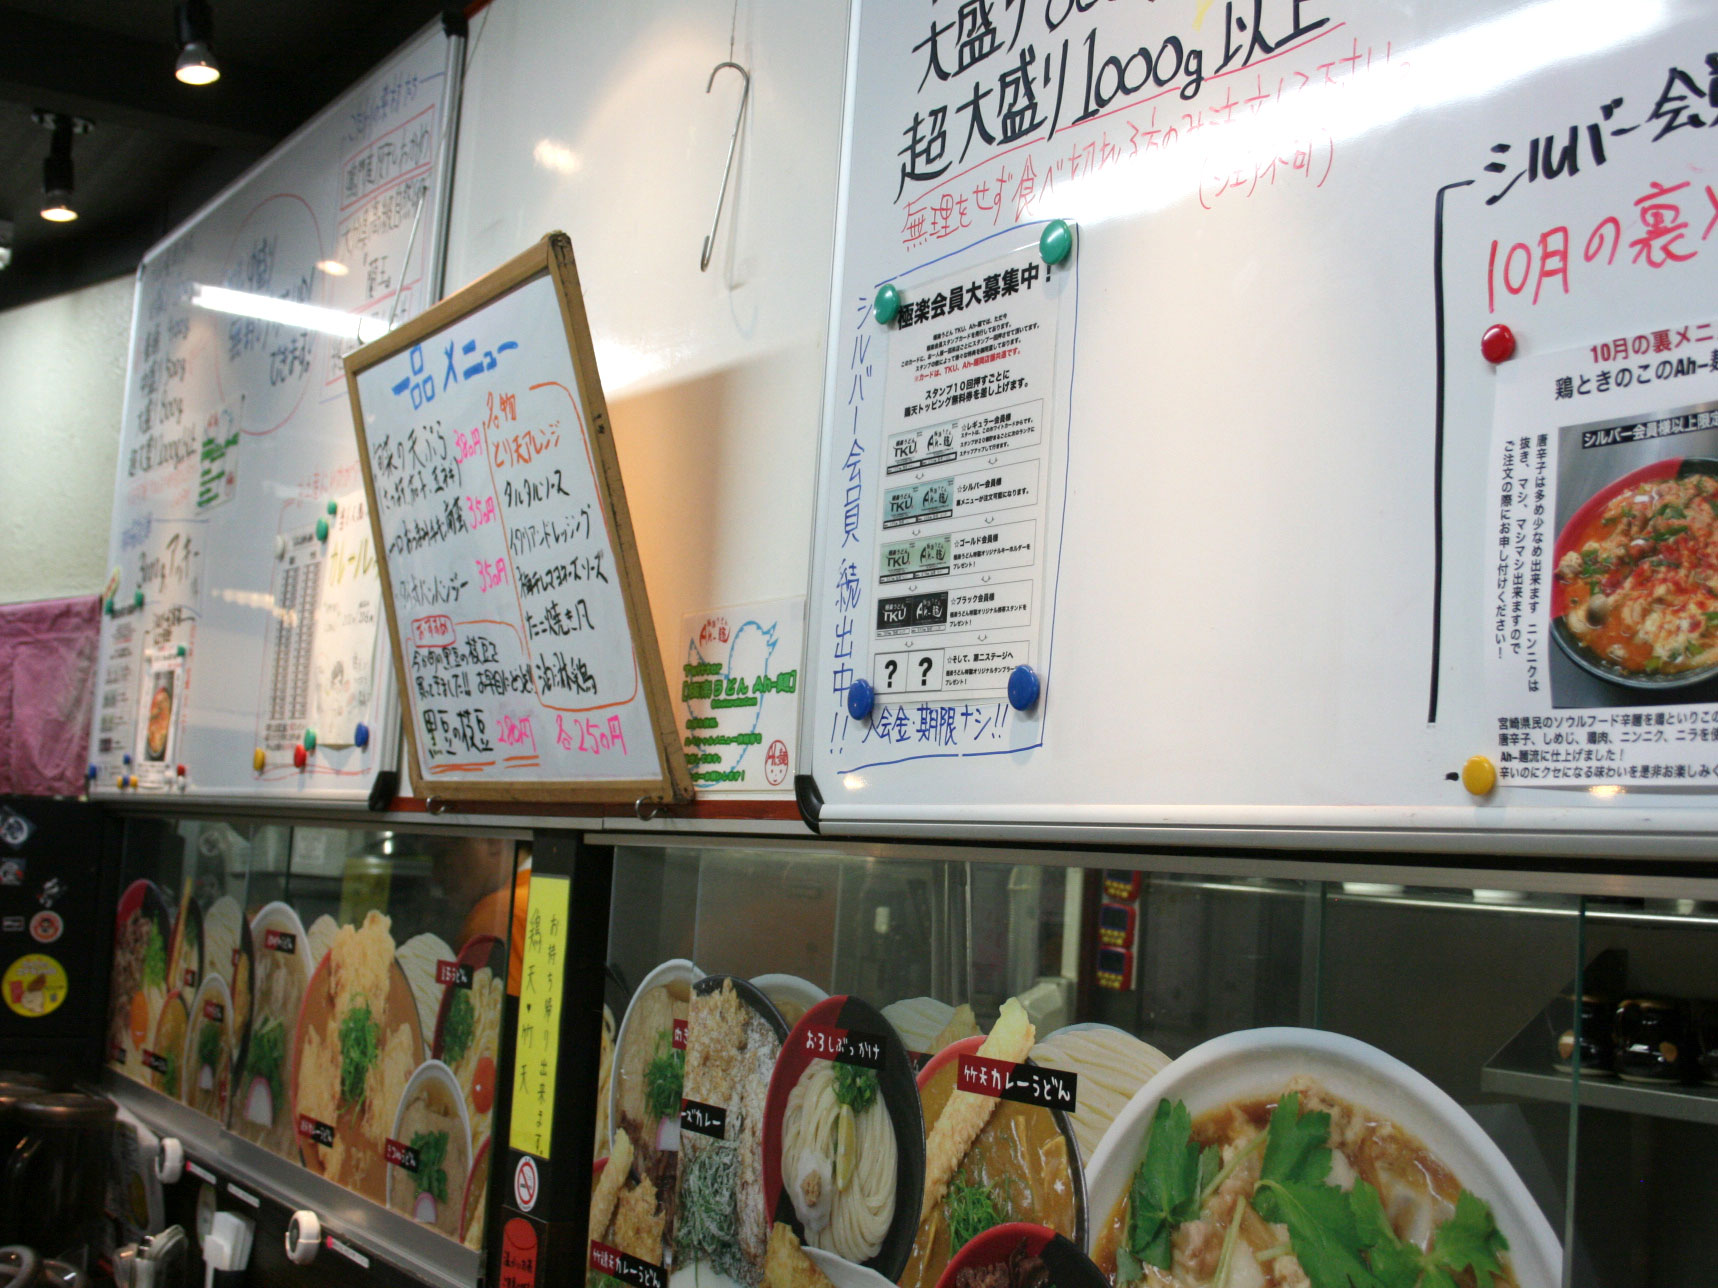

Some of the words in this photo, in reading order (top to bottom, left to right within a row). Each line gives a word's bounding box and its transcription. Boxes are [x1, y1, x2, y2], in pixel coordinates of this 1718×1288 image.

[1590, 323, 1718, 364] 10月の裏メニ
[805, 1028, 881, 1061] おろしぶっかけ
